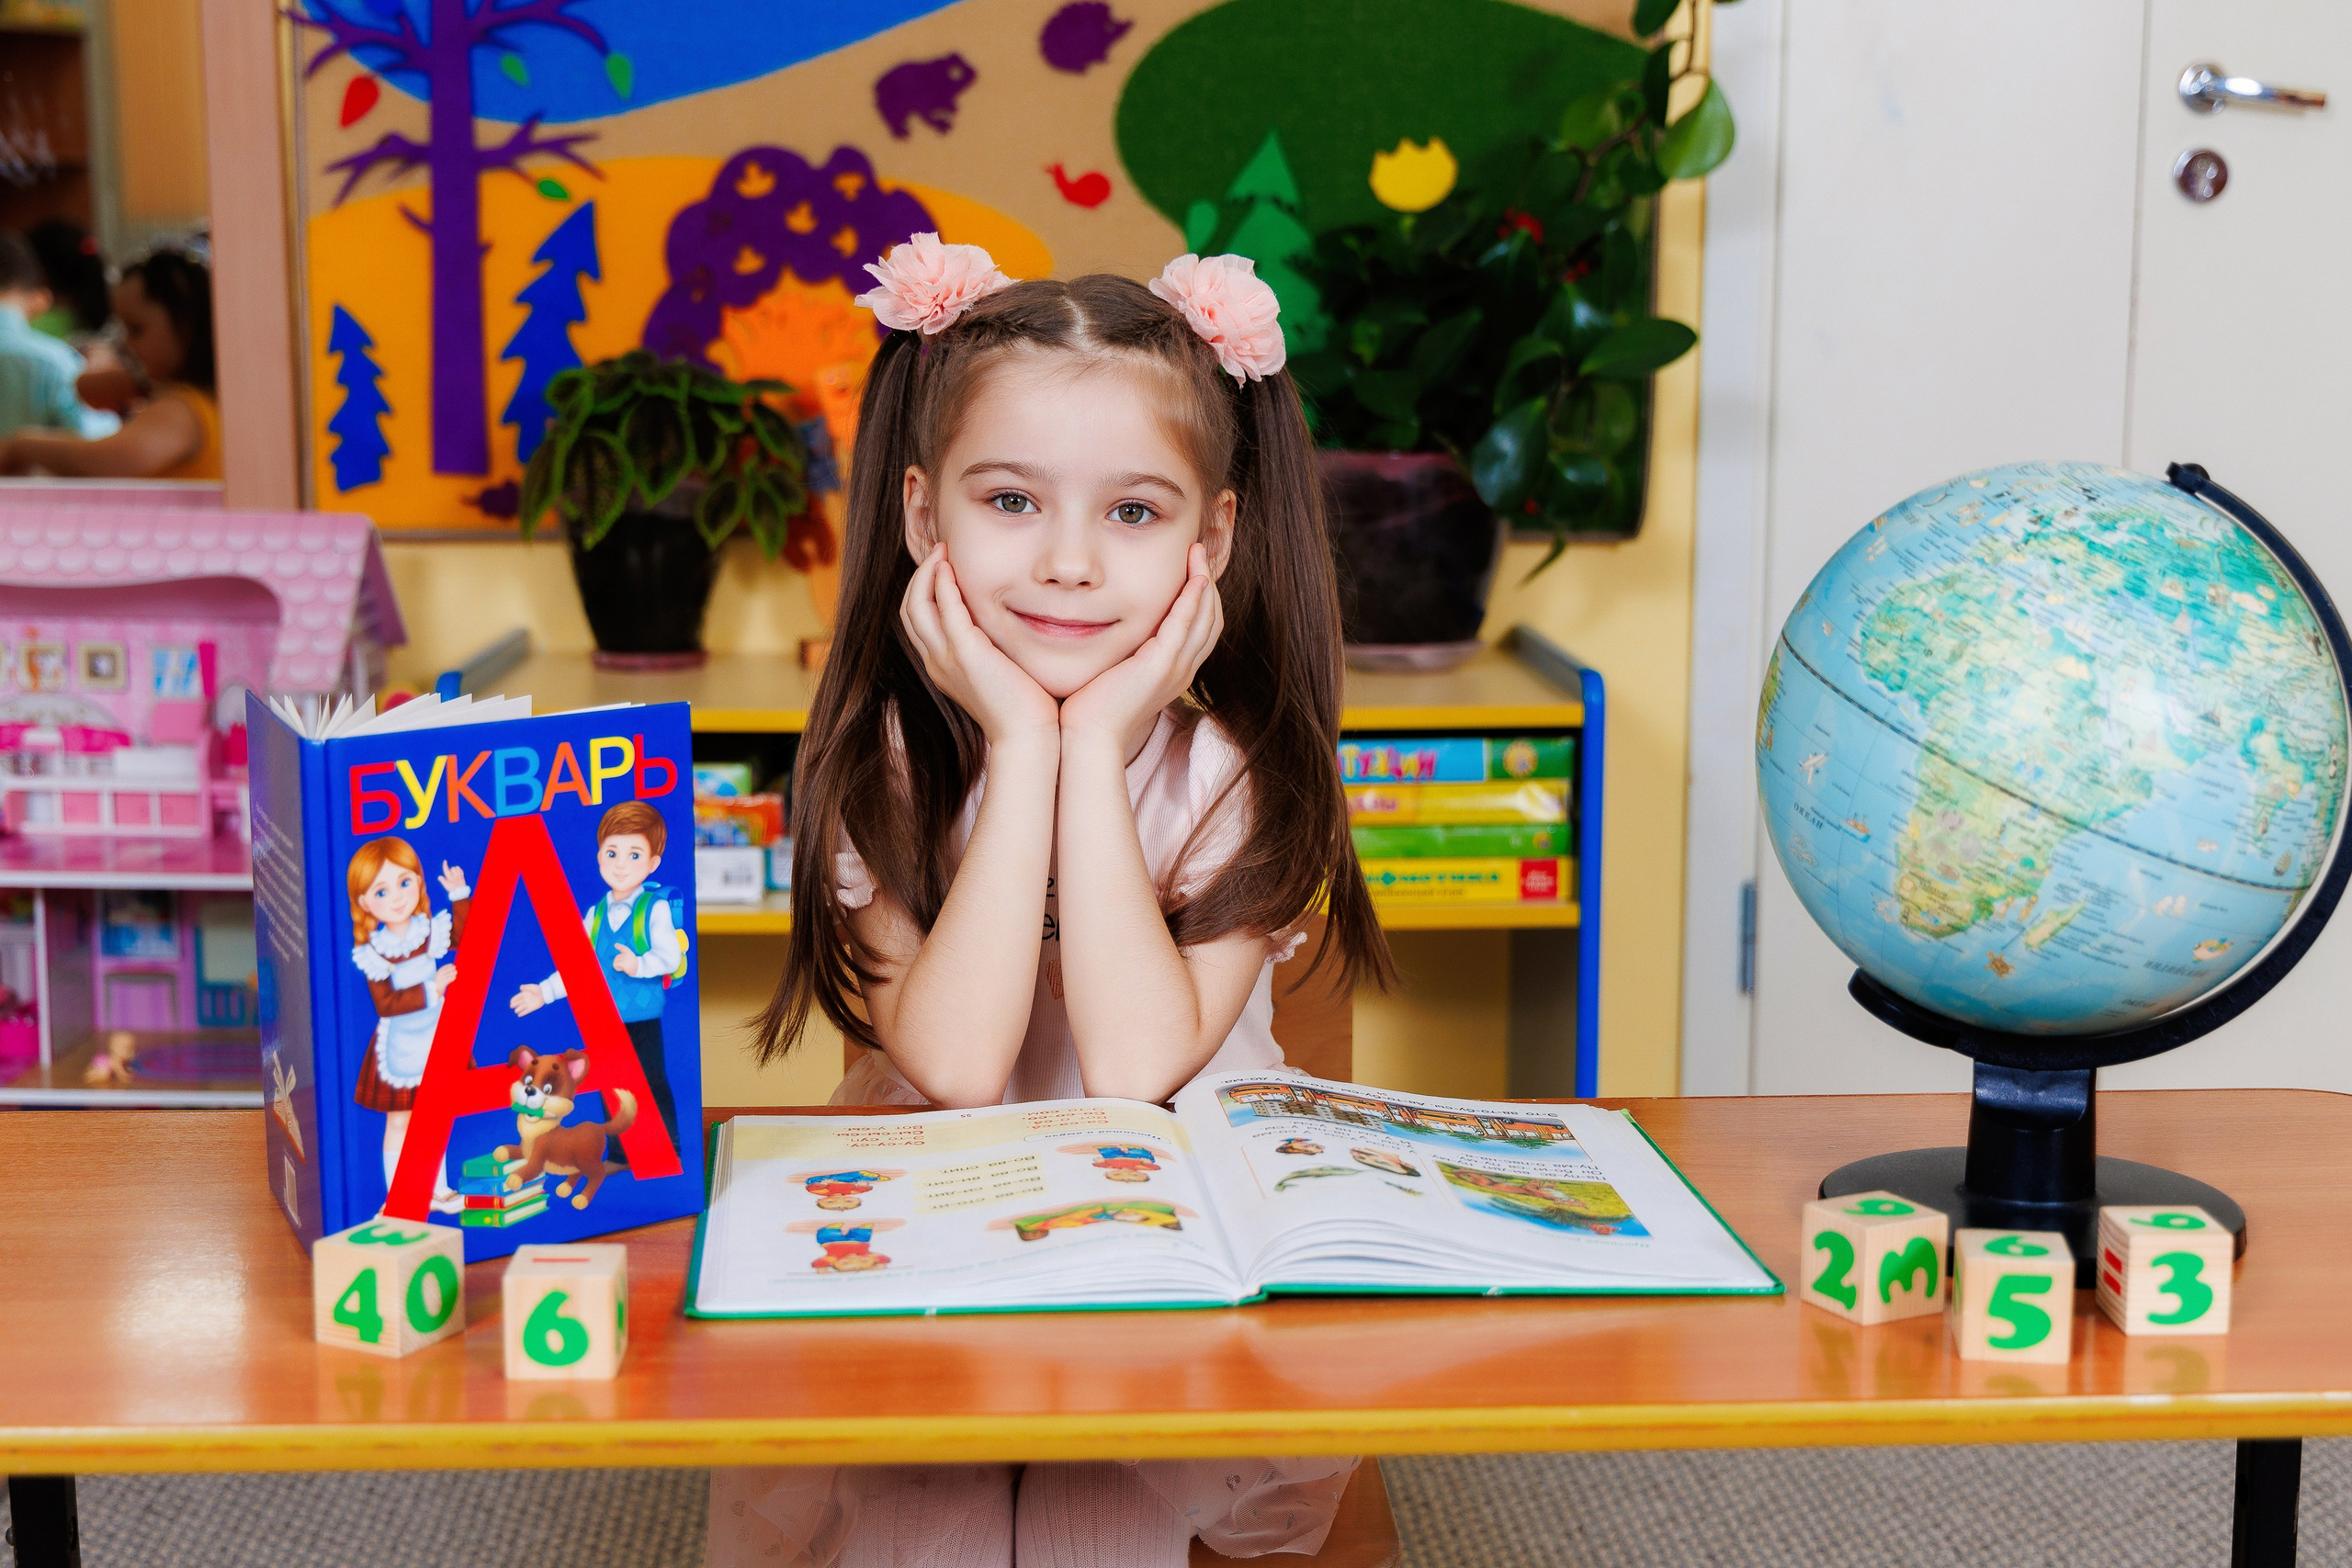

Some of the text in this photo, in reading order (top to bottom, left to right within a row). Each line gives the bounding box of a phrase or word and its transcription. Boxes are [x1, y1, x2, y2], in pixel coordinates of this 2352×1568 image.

[349, 733, 679, 836] БУКВАРЬ
[334, 1268, 384, 1344] 4
[406, 1254, 458, 1334] 0
[1812, 1230, 1857, 1311] 2
[2146, 1251, 2214, 1325] 3
[523, 1291, 589, 1367] 6
[1987, 1274, 2052, 1349] 5
